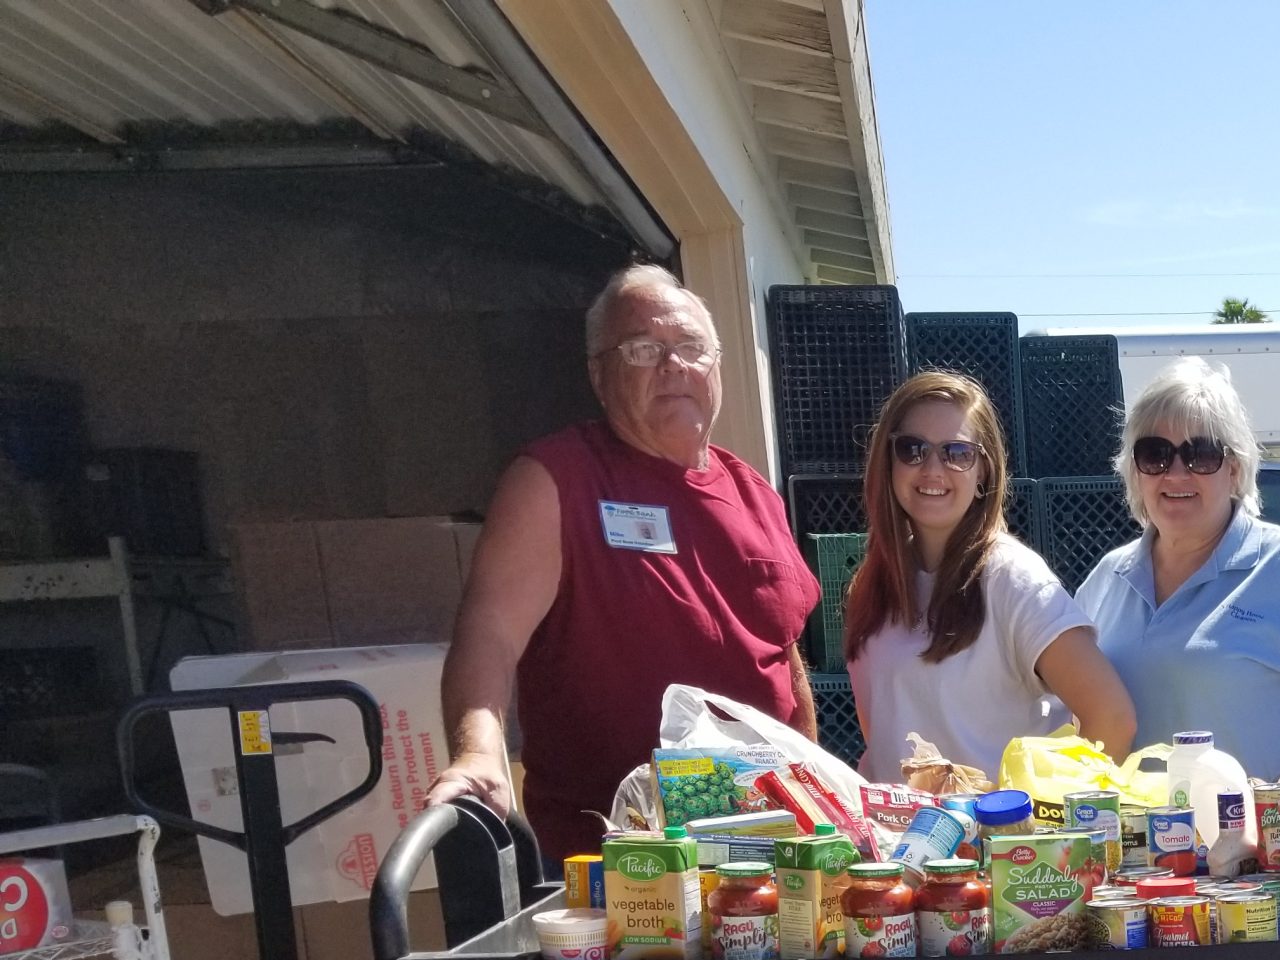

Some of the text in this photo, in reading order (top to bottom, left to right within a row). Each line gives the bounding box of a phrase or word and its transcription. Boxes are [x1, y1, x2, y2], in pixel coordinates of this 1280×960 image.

[396, 708, 410, 732] the
[383, 734, 396, 761] this
[400, 734, 420, 784] Protect
[417, 731, 437, 783] onment
[388, 764, 405, 810] Return
[877, 811, 899, 824] Pork
[1264, 808, 1277, 816] Chef
[1012, 853, 1034, 862] Crocker
[1016, 848, 1031, 856] Betty
[621, 855, 662, 877] Pacific
[824, 853, 849, 872] Pacific
[1007, 864, 1079, 893] Suddenly
[630, 885, 656, 894] organic
[1016, 888, 1071, 900] SALAD
[612, 898, 675, 915] vegetable
[1246, 906, 1270, 914] Nutrition
[627, 914, 664, 929] broth
[625, 936, 667, 944] LOW SODIUM
[719, 927, 768, 951] Simply
